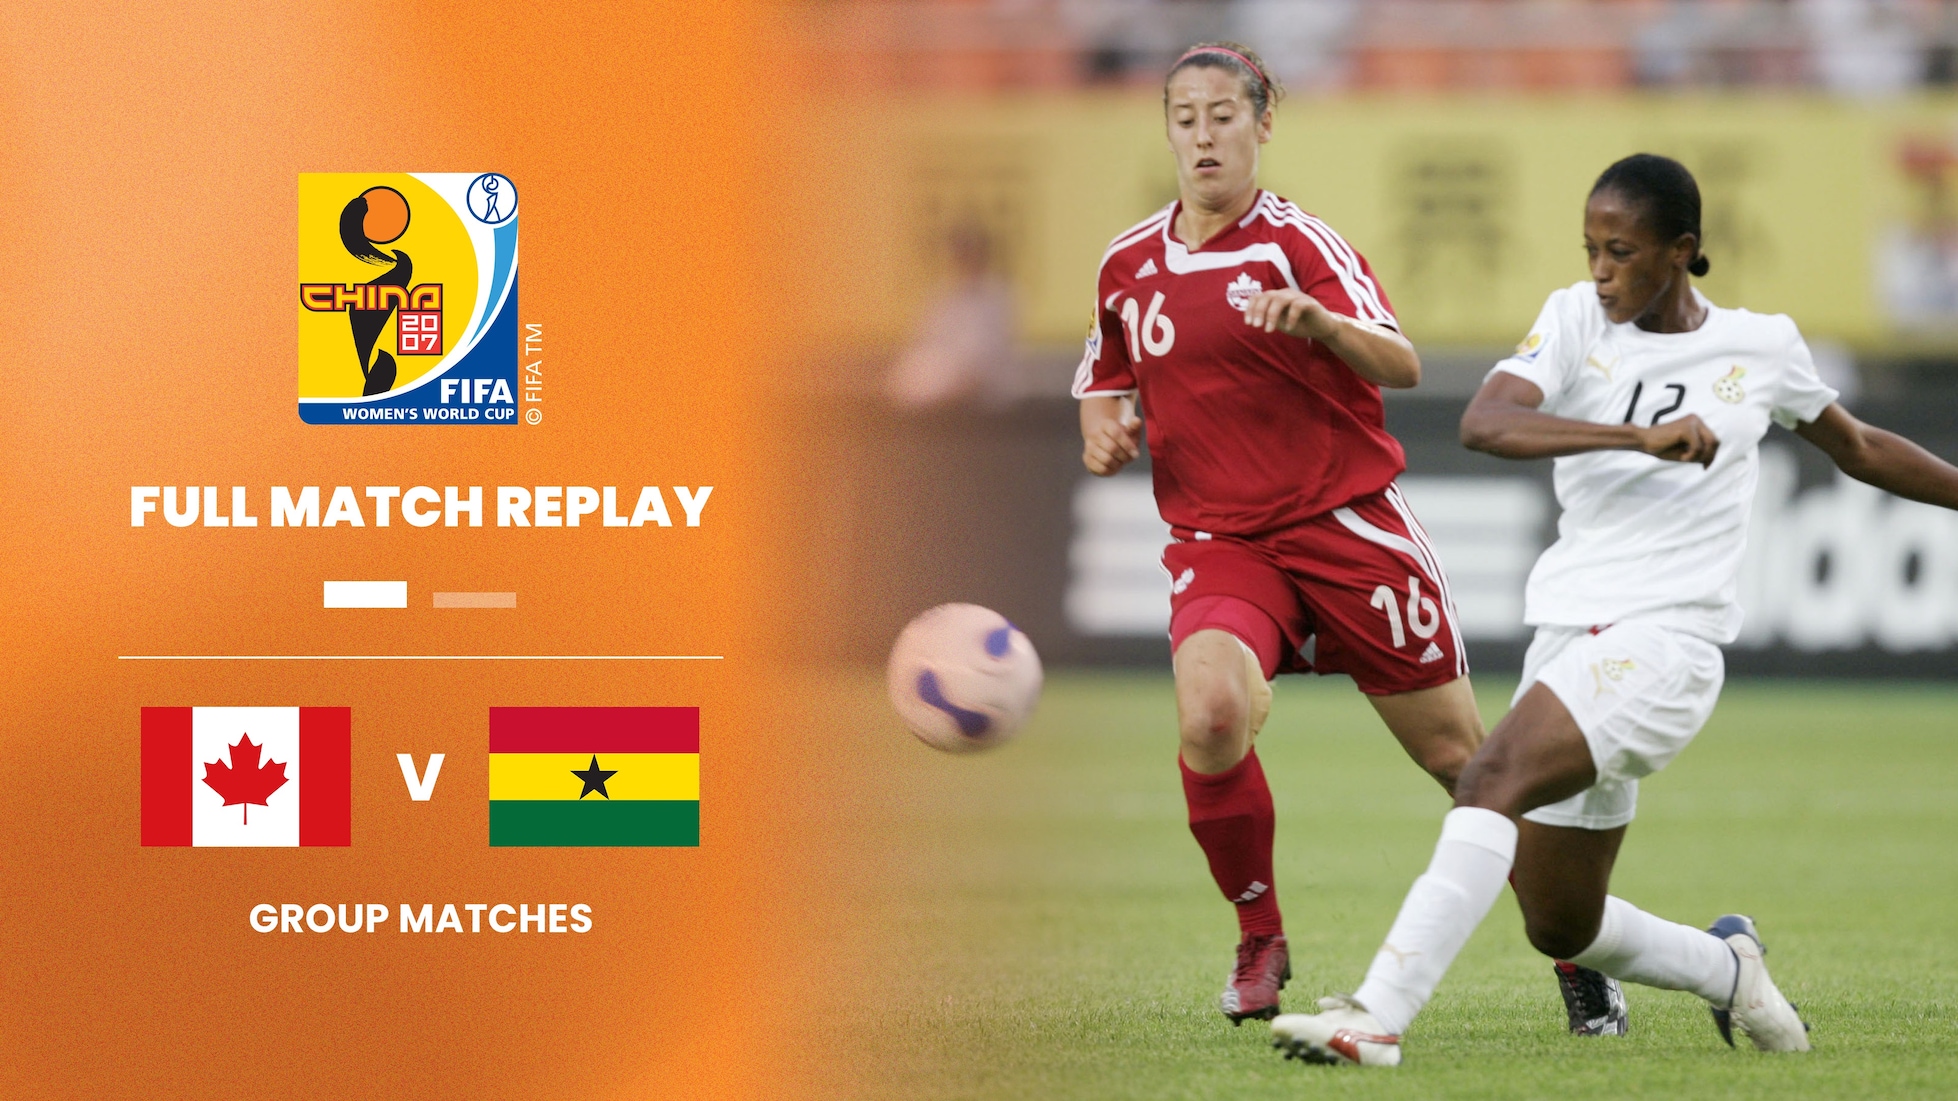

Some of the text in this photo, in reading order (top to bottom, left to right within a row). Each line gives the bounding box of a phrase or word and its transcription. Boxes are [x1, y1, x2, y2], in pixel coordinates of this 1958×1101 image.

[1121, 290, 1176, 363] 16
[1623, 380, 1686, 426] 12
[1370, 575, 1440, 649] 16
